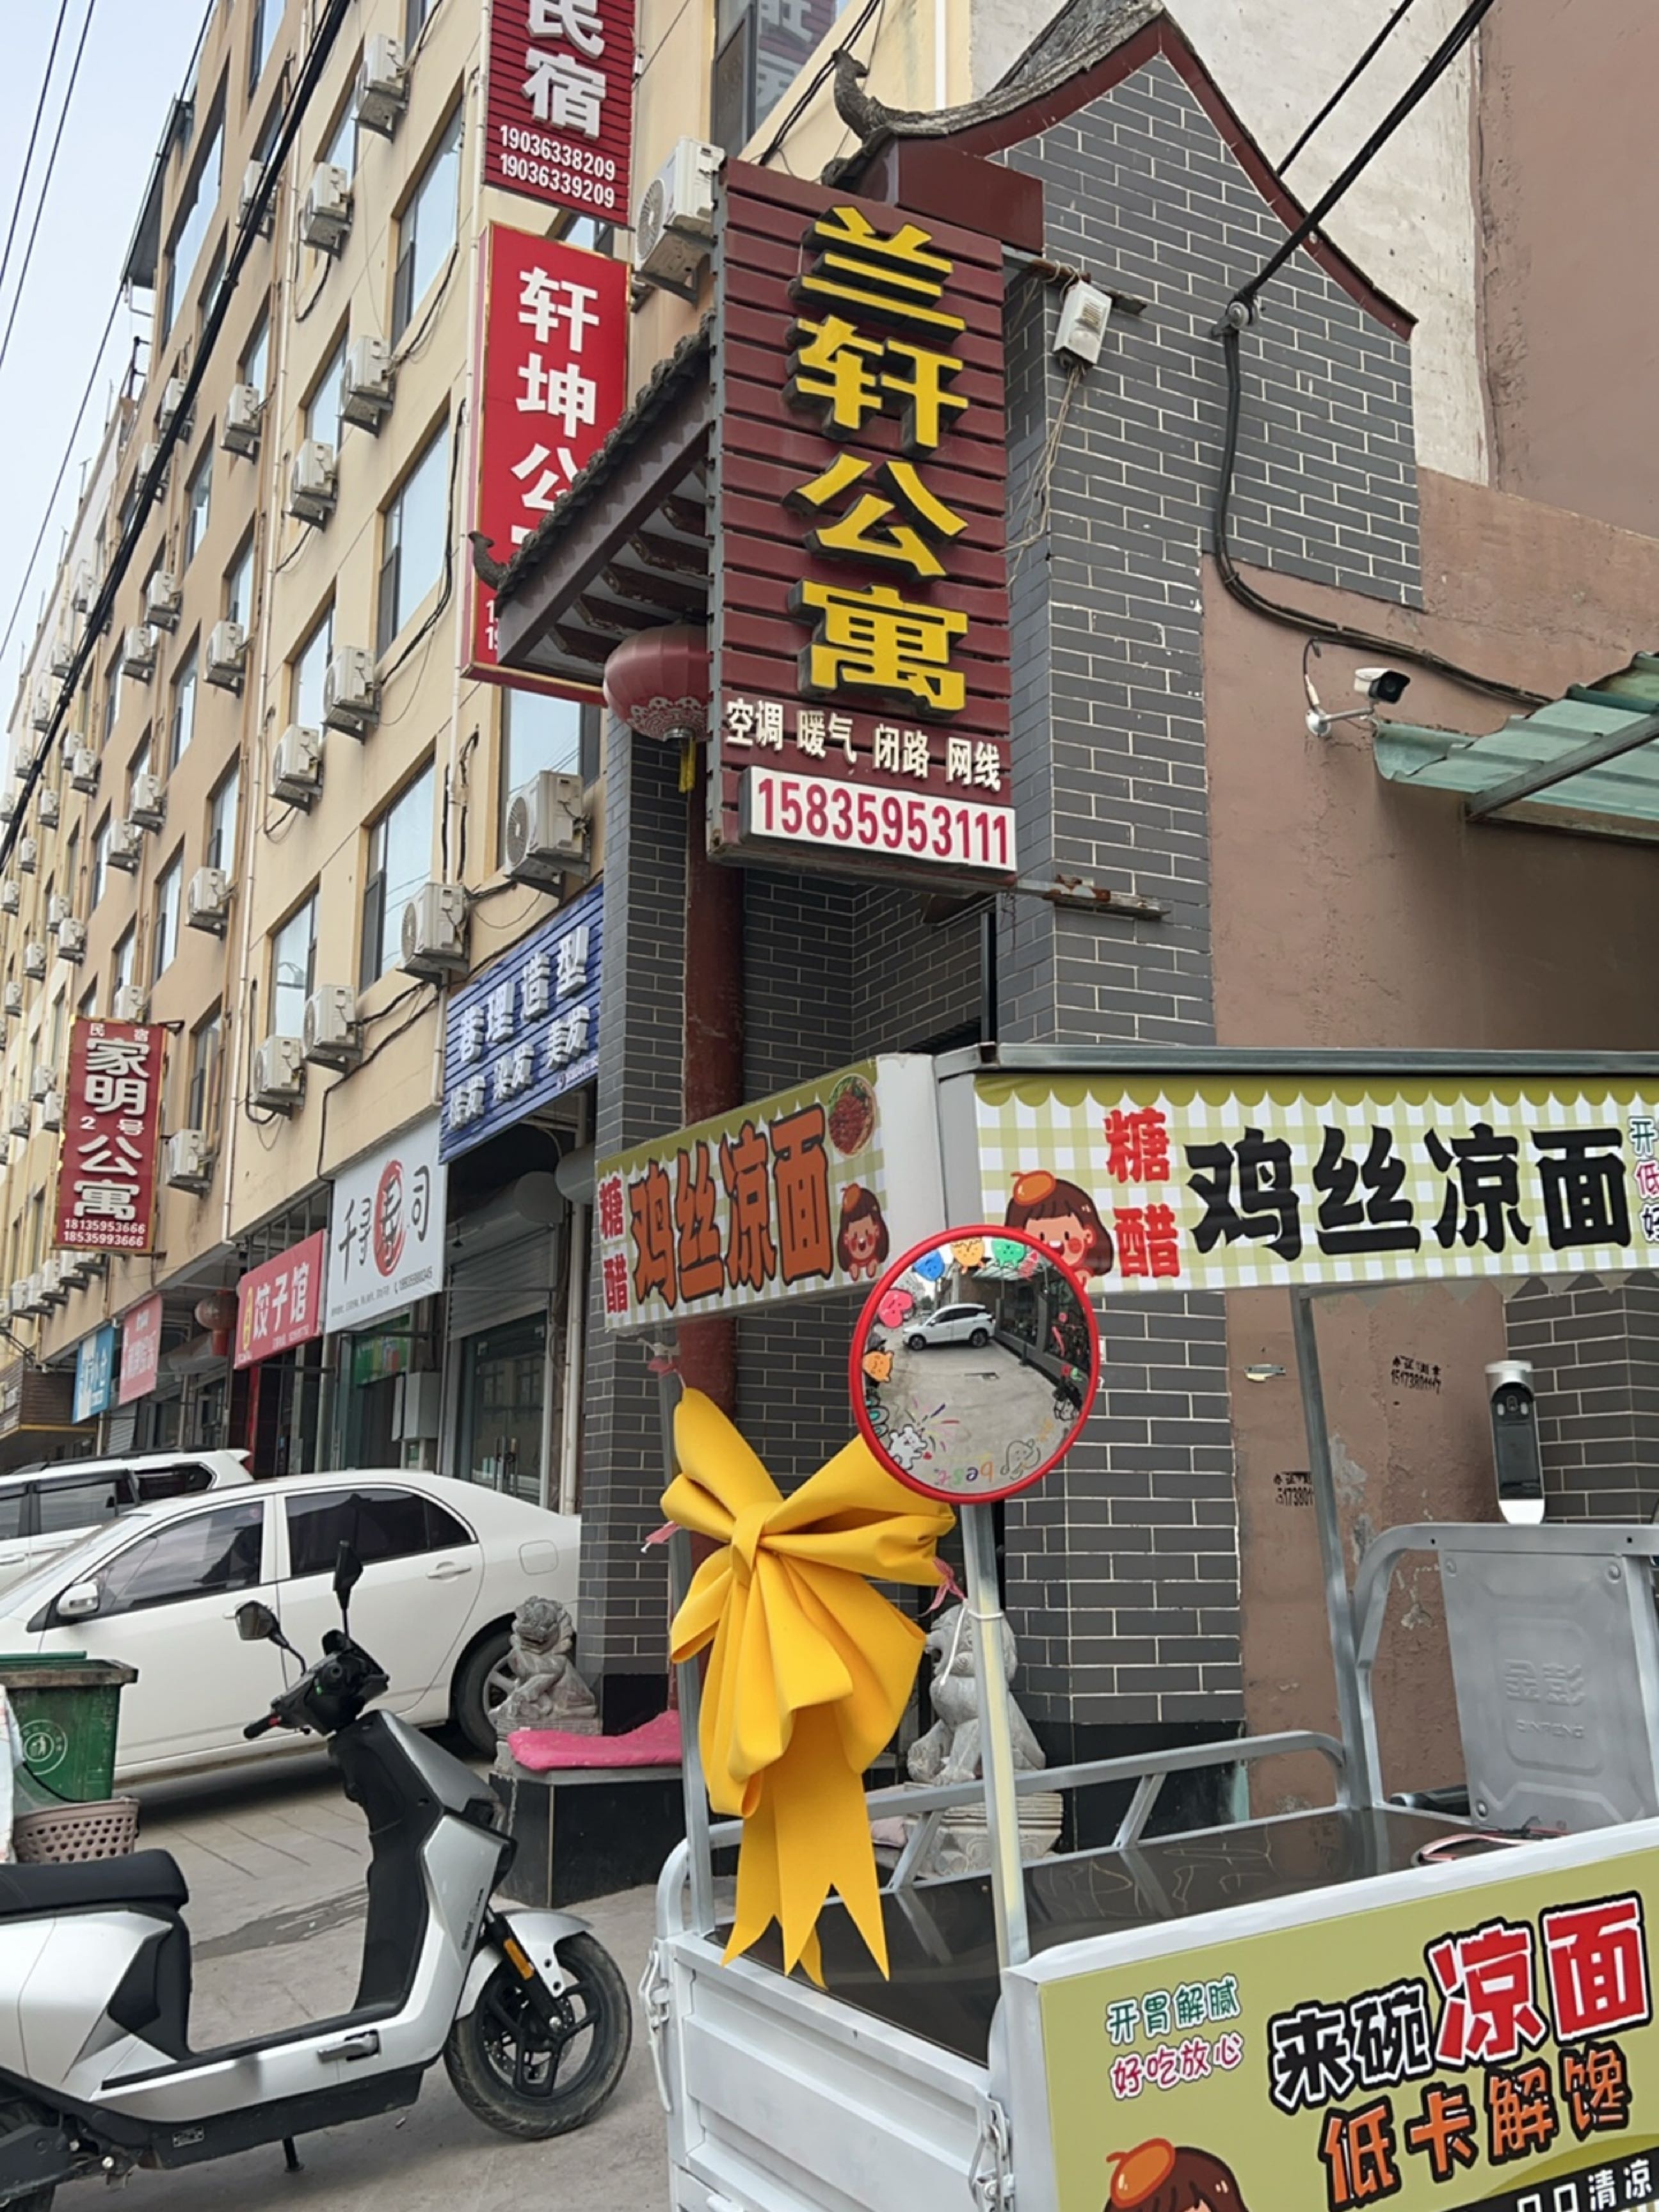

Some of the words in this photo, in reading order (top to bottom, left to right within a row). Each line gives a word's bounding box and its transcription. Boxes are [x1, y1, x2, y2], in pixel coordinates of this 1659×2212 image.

[500, 125, 615, 181] 19036338209
[501, 153, 614, 208] 19036339209
[511, 266, 599, 546] 轩坤公
[794, 205, 968, 712] 兰轩公寓
[725, 698, 783, 751] 空调
[796, 709, 857, 764] 暖气
[872, 723, 929, 778] 闭路
[947, 737, 1001, 792] 网线
[758, 778, 1007, 865] 15835953111
[598, 1176, 628, 1313] 糖醋
[629, 1103, 833, 1310] 鸡丝凉面
[1103, 1107, 1181, 1278] 糖醋
[1183, 1123, 1631, 1262] 鸡丝凉面
[253, 1262, 310, 1342] 饺子馆
[1109, 1978, 1238, 2042] 开胃解腻
[1113, 2035, 1241, 2095] 好吃放心
[1272, 1895, 1651, 2106] 来碗凉面
[1322, 2048, 1626, 2204] 低卡解馋
